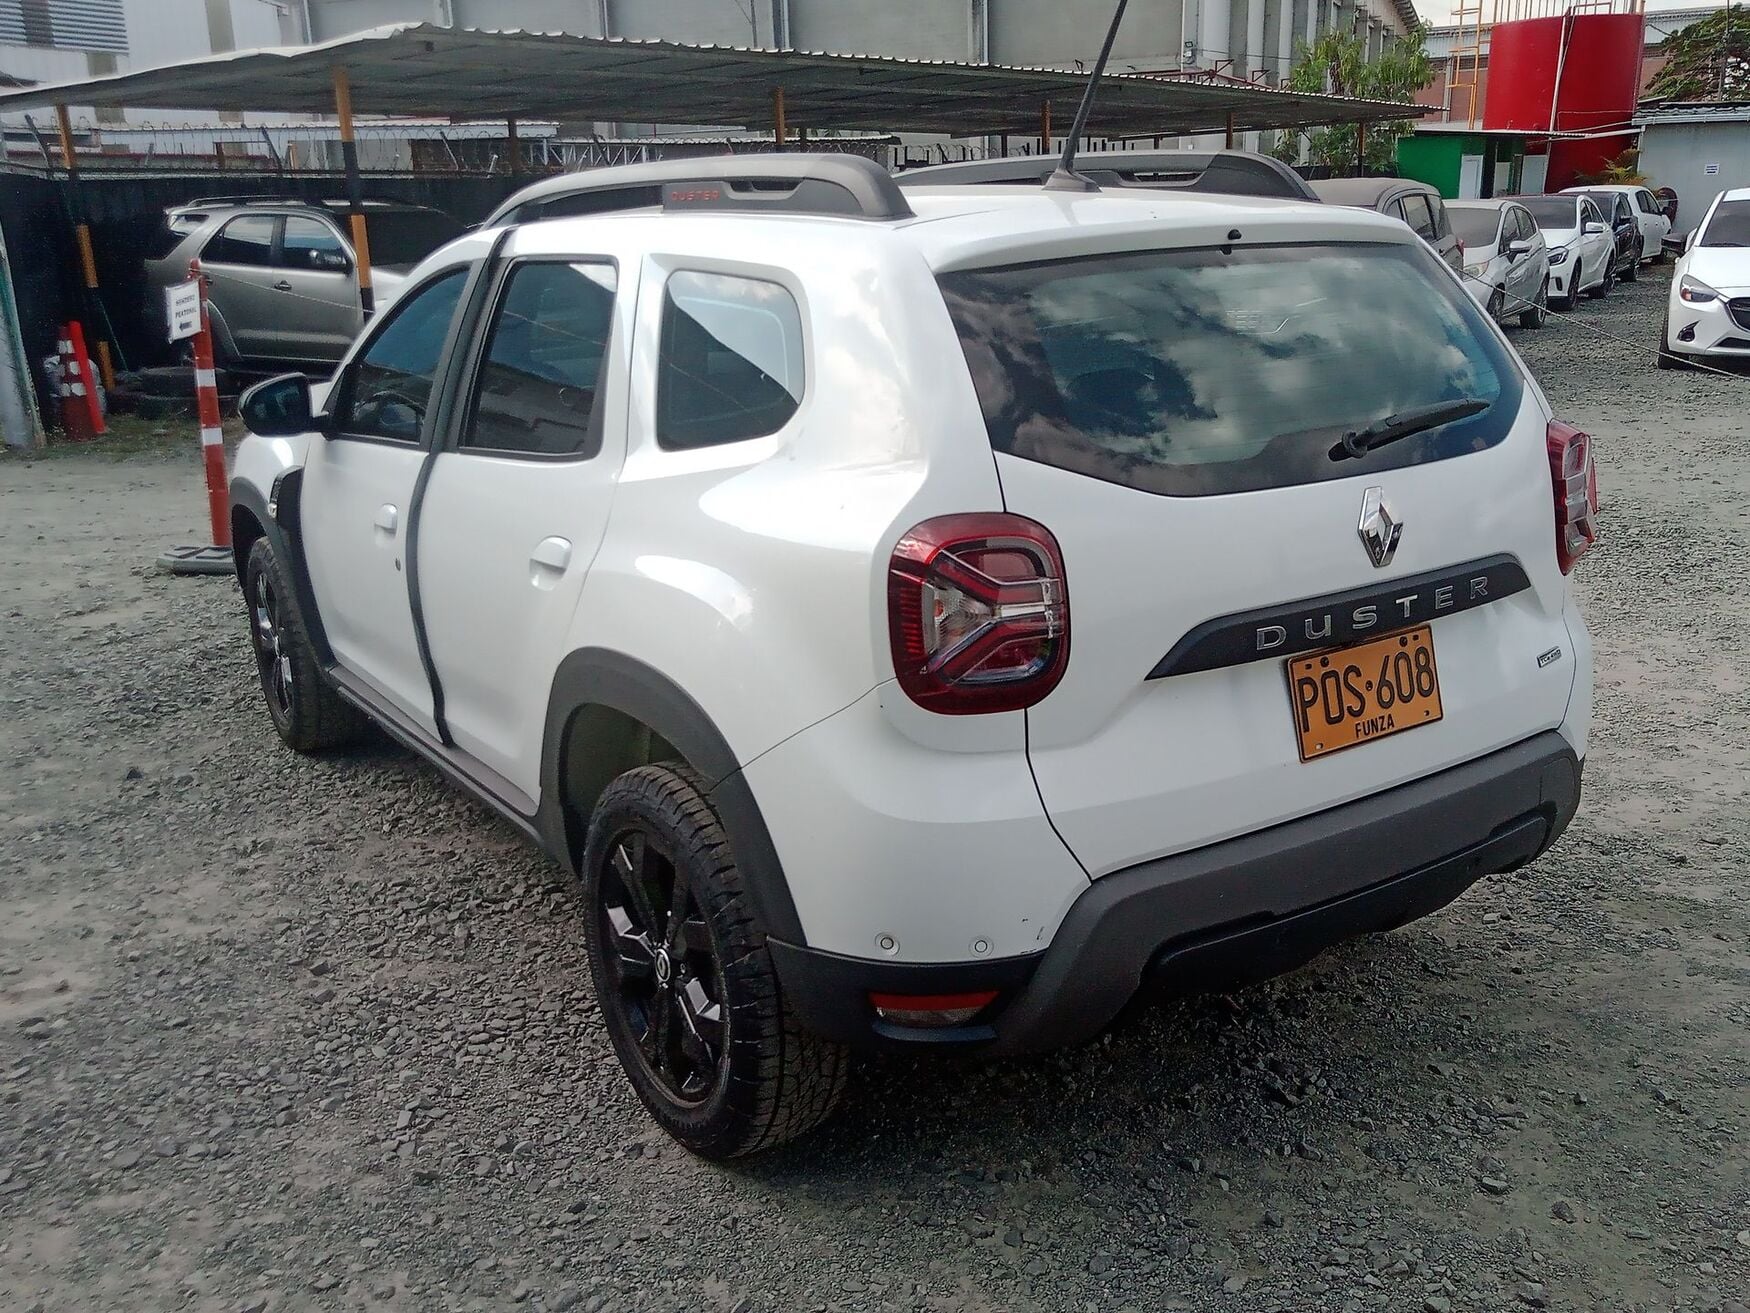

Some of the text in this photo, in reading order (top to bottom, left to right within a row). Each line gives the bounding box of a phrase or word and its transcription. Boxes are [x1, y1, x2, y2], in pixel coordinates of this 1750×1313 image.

[671, 190, 720, 201] DUSTER
[1256, 576, 1489, 651] DUSTER
[1354, 713, 1396, 738] FUNZA
